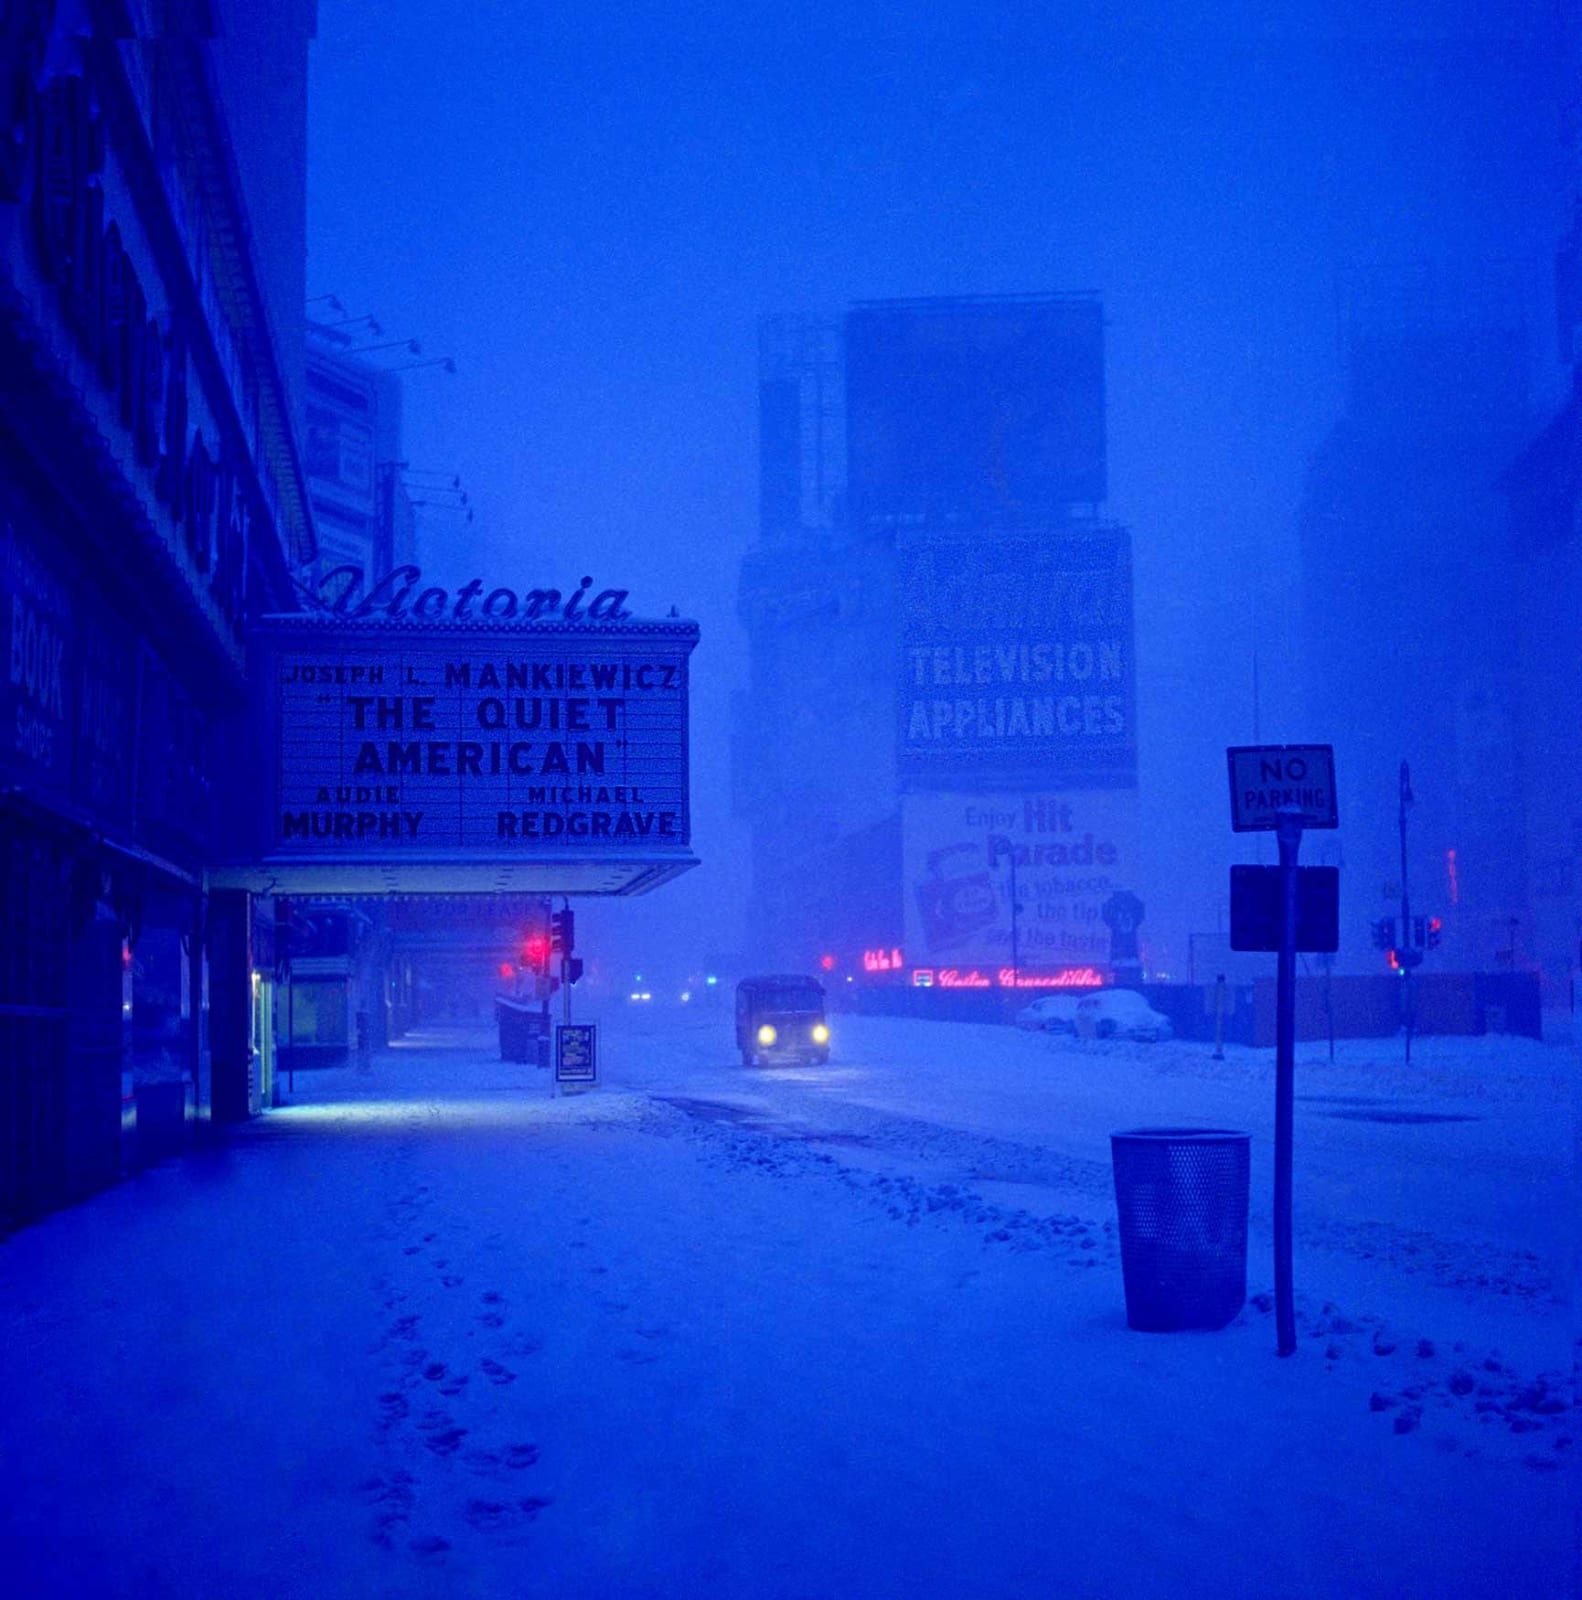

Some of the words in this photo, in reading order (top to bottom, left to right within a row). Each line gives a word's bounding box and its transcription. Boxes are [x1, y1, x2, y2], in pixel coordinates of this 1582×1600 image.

[317, 564, 633, 623] Victoria
[10, 592, 65, 720] BOOK
[908, 641, 1122, 686] TELEVISION
[286, 665, 384, 685] JOSEPH
[406, 668, 427, 687] L.
[445, 662, 679, 690] MANKIEWICZ
[476, 696, 626, 732] QUIET
[907, 695, 1125, 739] APPLIANCES
[1260, 758, 1307, 782] NO
[316, 785, 400, 805] AUDIE
[527, 785, 644, 805] MICHAEL
[1244, 787, 1325, 810] PARKING
[282, 811, 425, 840] MURPHY
[497, 811, 678, 839] REDGRAVE
[964, 805, 1017, 831] Enjoy
[1022, 799, 1074, 833] Hit
[986, 833, 1118, 868] Parade
